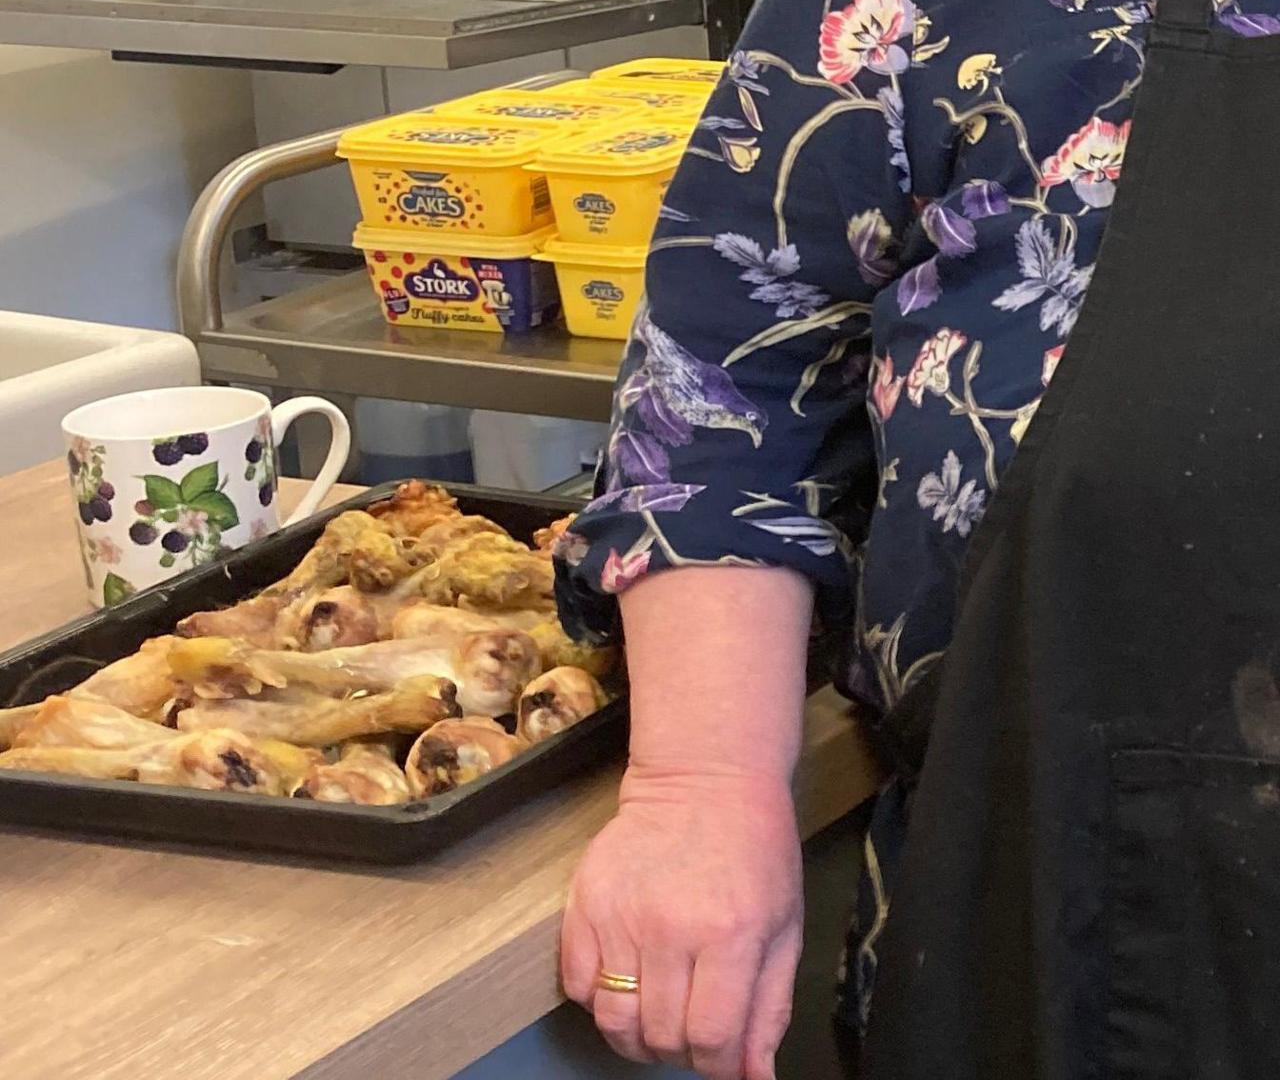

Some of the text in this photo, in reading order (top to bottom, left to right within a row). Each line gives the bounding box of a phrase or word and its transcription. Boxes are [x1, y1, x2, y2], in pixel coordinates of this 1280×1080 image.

[399, 193, 461, 217] CAKES
[575, 198, 614, 214] CAKES
[412, 275, 472, 295] STORK
[583, 284, 623, 300] CAKES
[410, 307, 449, 324] Fluffy
